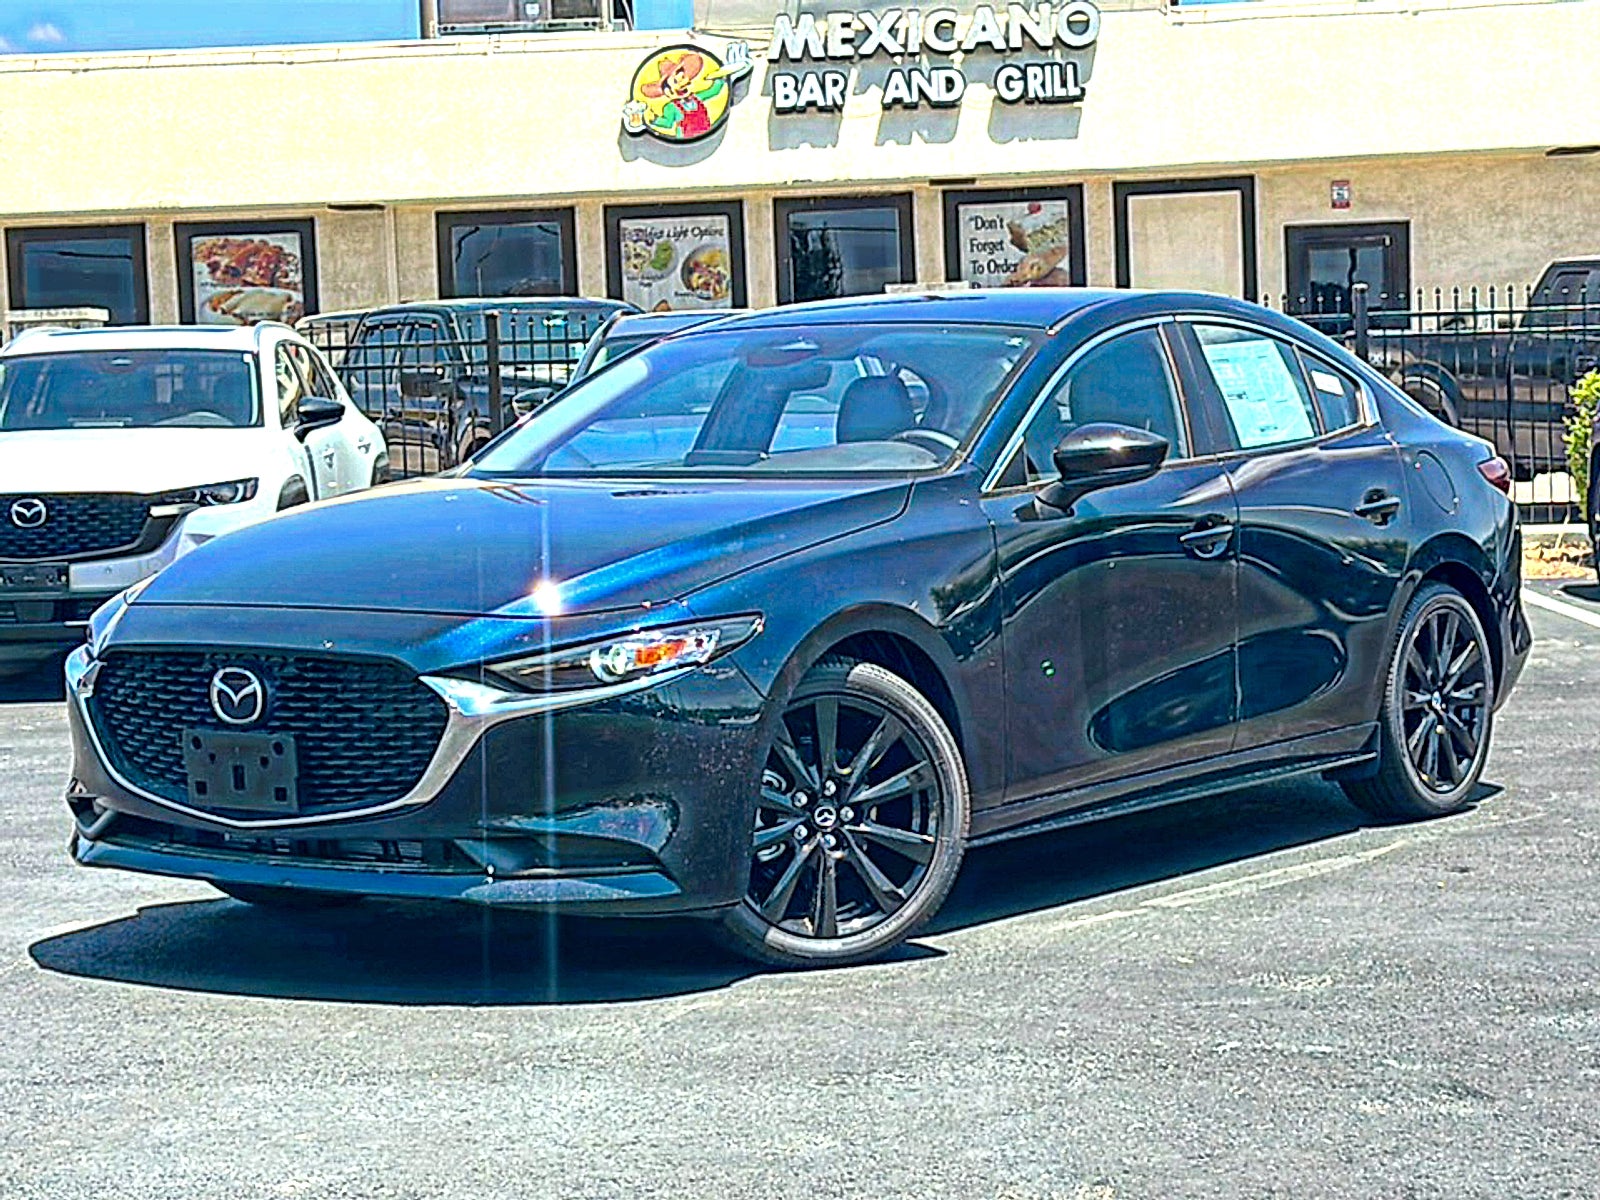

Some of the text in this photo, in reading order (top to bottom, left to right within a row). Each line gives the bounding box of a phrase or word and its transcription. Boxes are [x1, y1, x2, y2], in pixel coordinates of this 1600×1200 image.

[768, 1, 1100, 59] MEXICANO
[774, 62, 1085, 111] BAR AND GRILL
[969, 237, 1004, 255] Forget
[969, 259, 1018, 274] To Order
